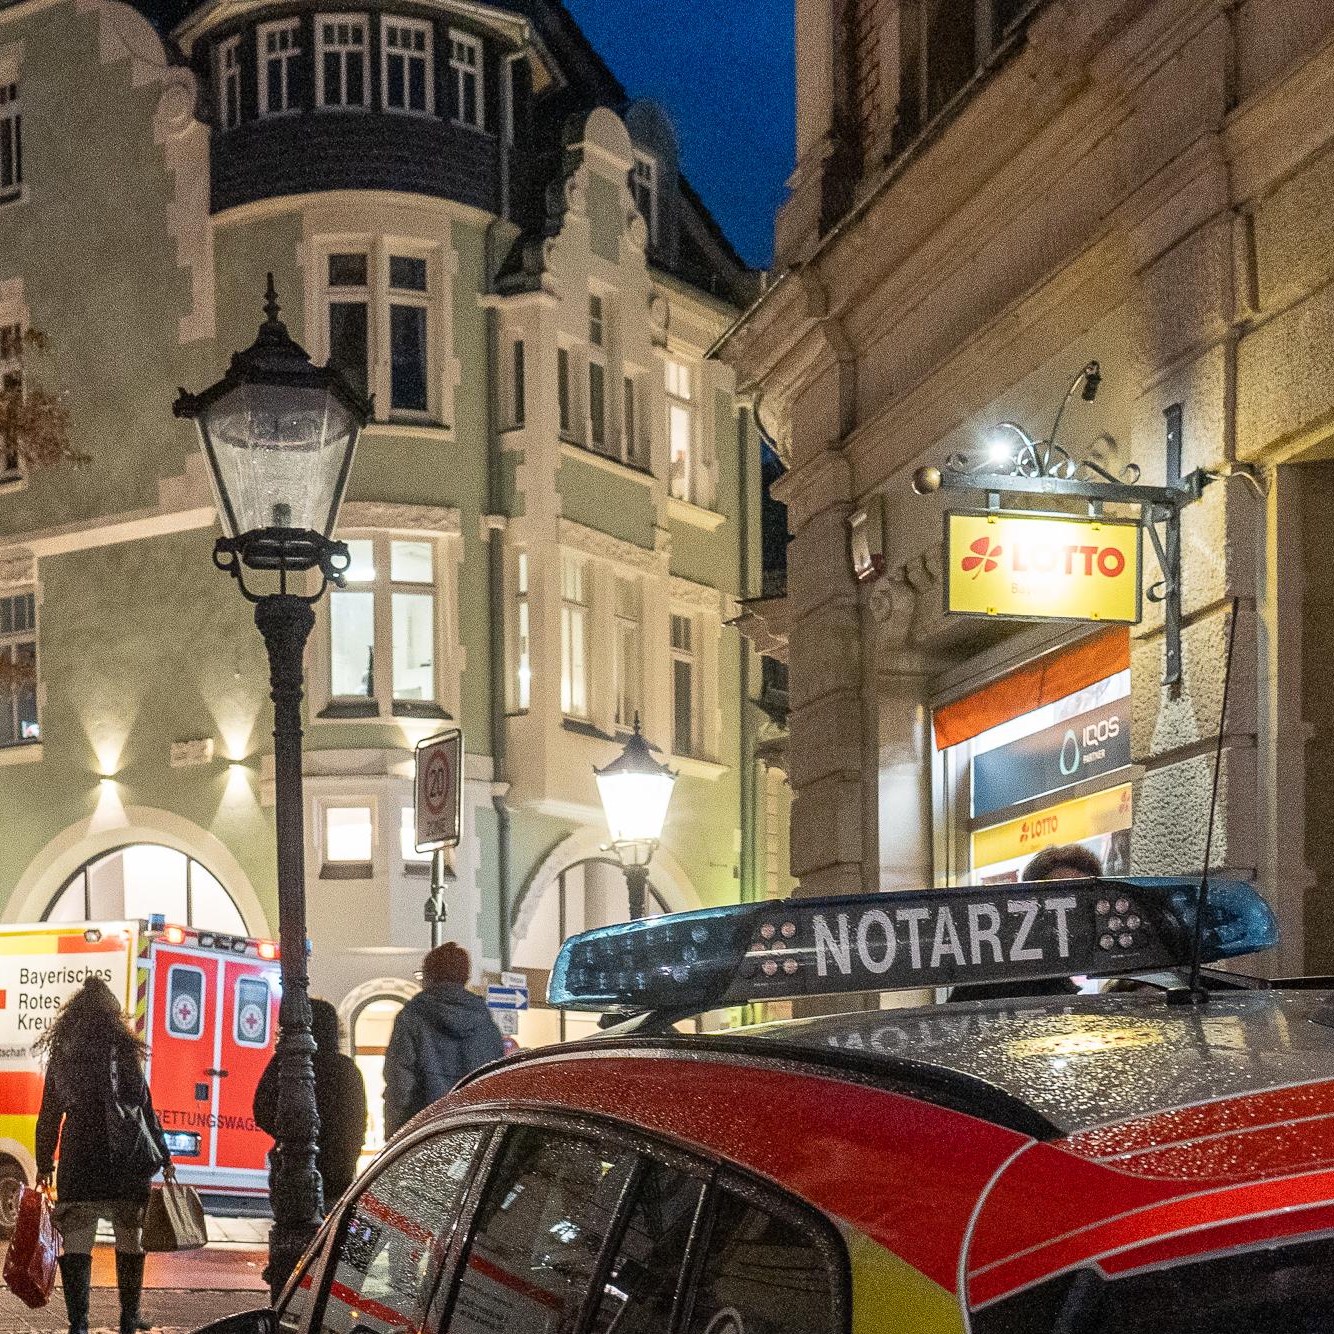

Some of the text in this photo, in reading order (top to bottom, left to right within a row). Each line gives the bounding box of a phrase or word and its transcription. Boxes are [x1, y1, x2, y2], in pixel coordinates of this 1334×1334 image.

[1011, 546, 1126, 578] LOTTO
[1082, 716, 1120, 747] IQOS
[427, 766, 447, 801] 20
[1030, 816, 1059, 840] LOTTO
[811, 897, 1078, 978] NOTARZT
[19, 965, 112, 987] Bayerisches
[18, 991, 60, 1010] Rotes
[155, 1109, 262, 1132] RETTUNGSWAG
